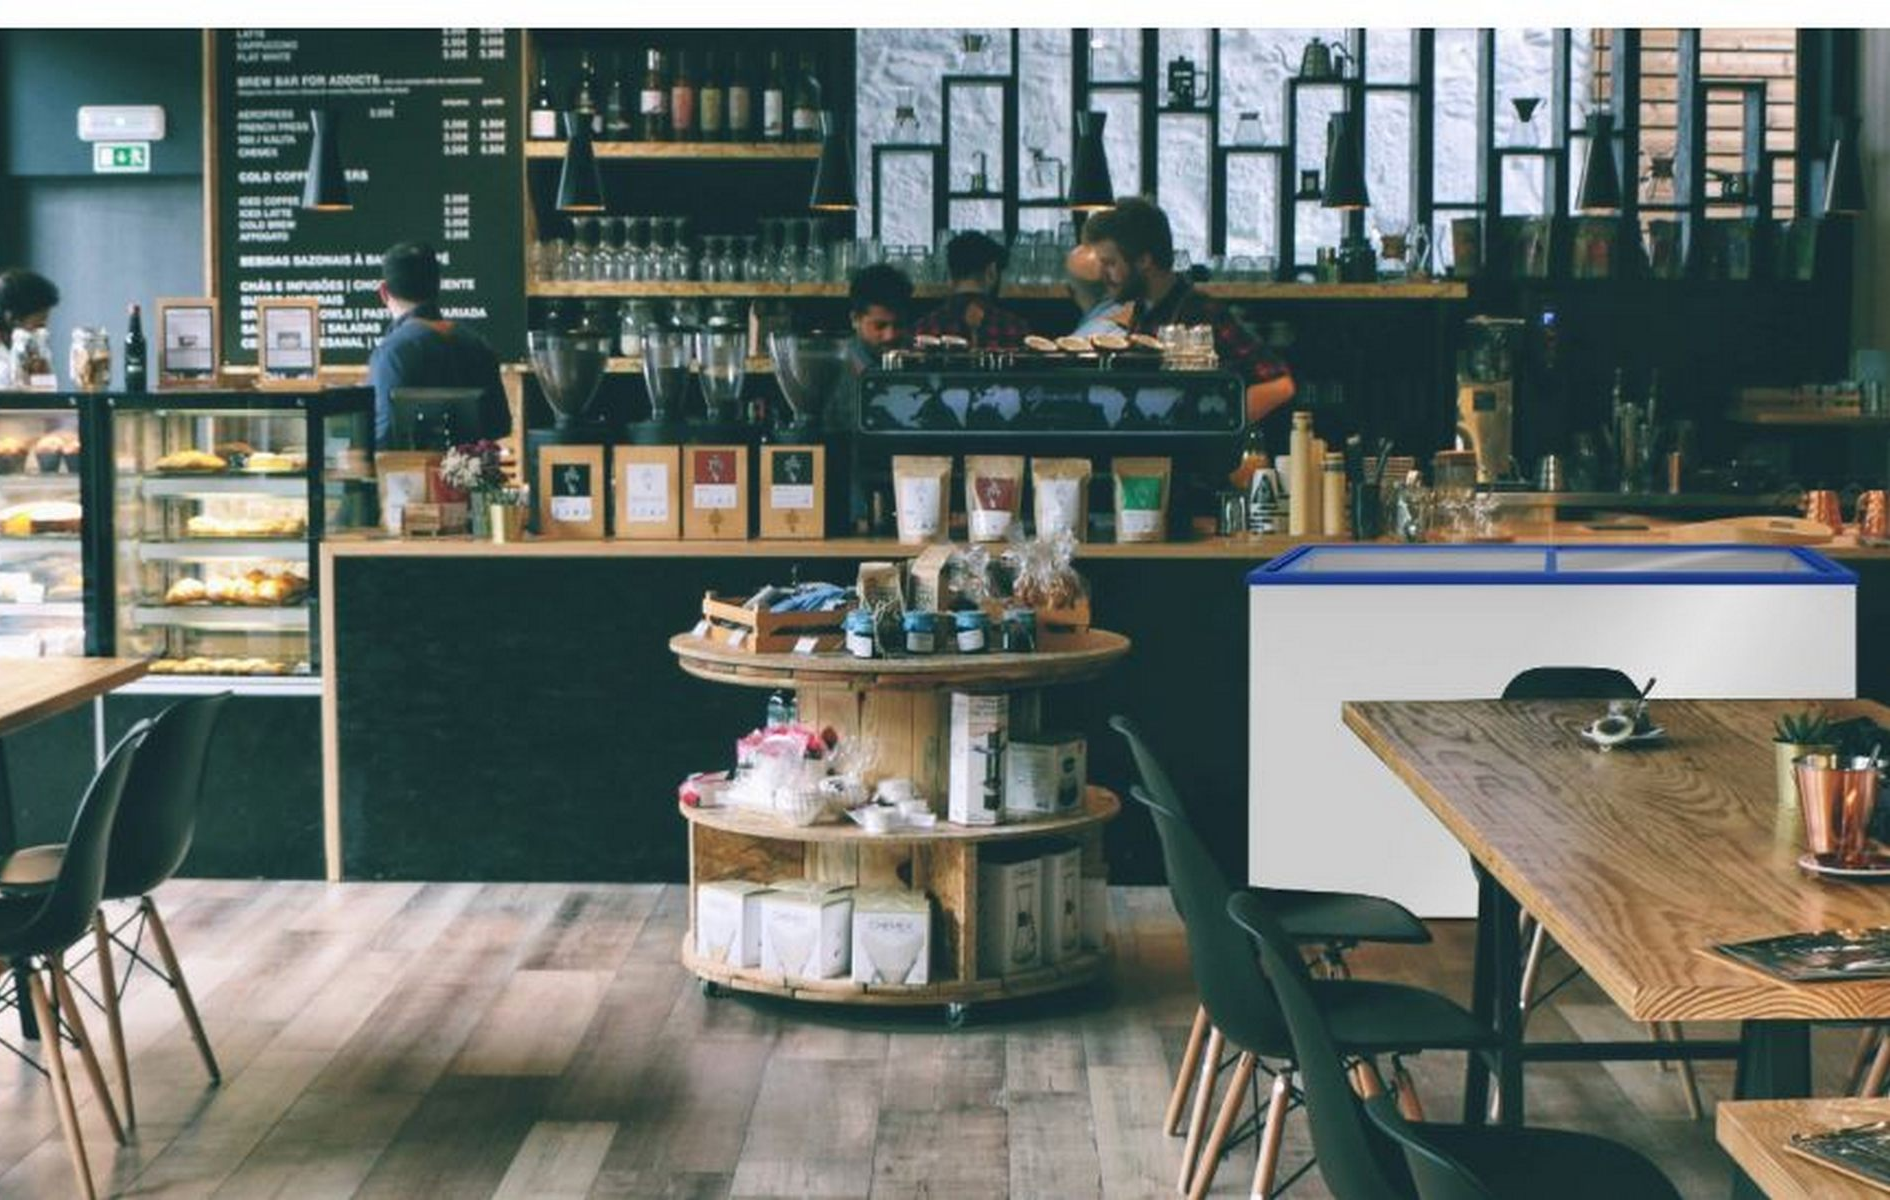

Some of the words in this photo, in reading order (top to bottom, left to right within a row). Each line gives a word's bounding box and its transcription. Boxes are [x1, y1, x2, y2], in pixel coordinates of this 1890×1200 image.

[237, 76, 272, 87] BREW
[275, 75, 299, 87] BAR
[302, 75, 326, 86] FOR
[328, 74, 381, 86] ADDICTS
[237, 122, 276, 131] FRENCH
[278, 122, 309, 132] PRESS
[238, 171, 271, 183] COLD
[274, 171, 308, 183] COFF
[239, 197, 261, 206] ICED
[264, 196, 300, 206] COFFEE
[239, 209, 261, 218] ICED
[264, 209, 293, 218] LATTE
[239, 220, 266, 229] COLD
[268, 220, 297, 230] BREW
[239, 232, 289, 242] AFFOGATO
[239, 255, 290, 267] BEBIDAS
[293, 254, 351, 266] SAZONAIS
[275, 281, 282, 292] E
[286, 279, 344, 292] INFUSÕES
[328, 322, 381, 334] SALADAS
